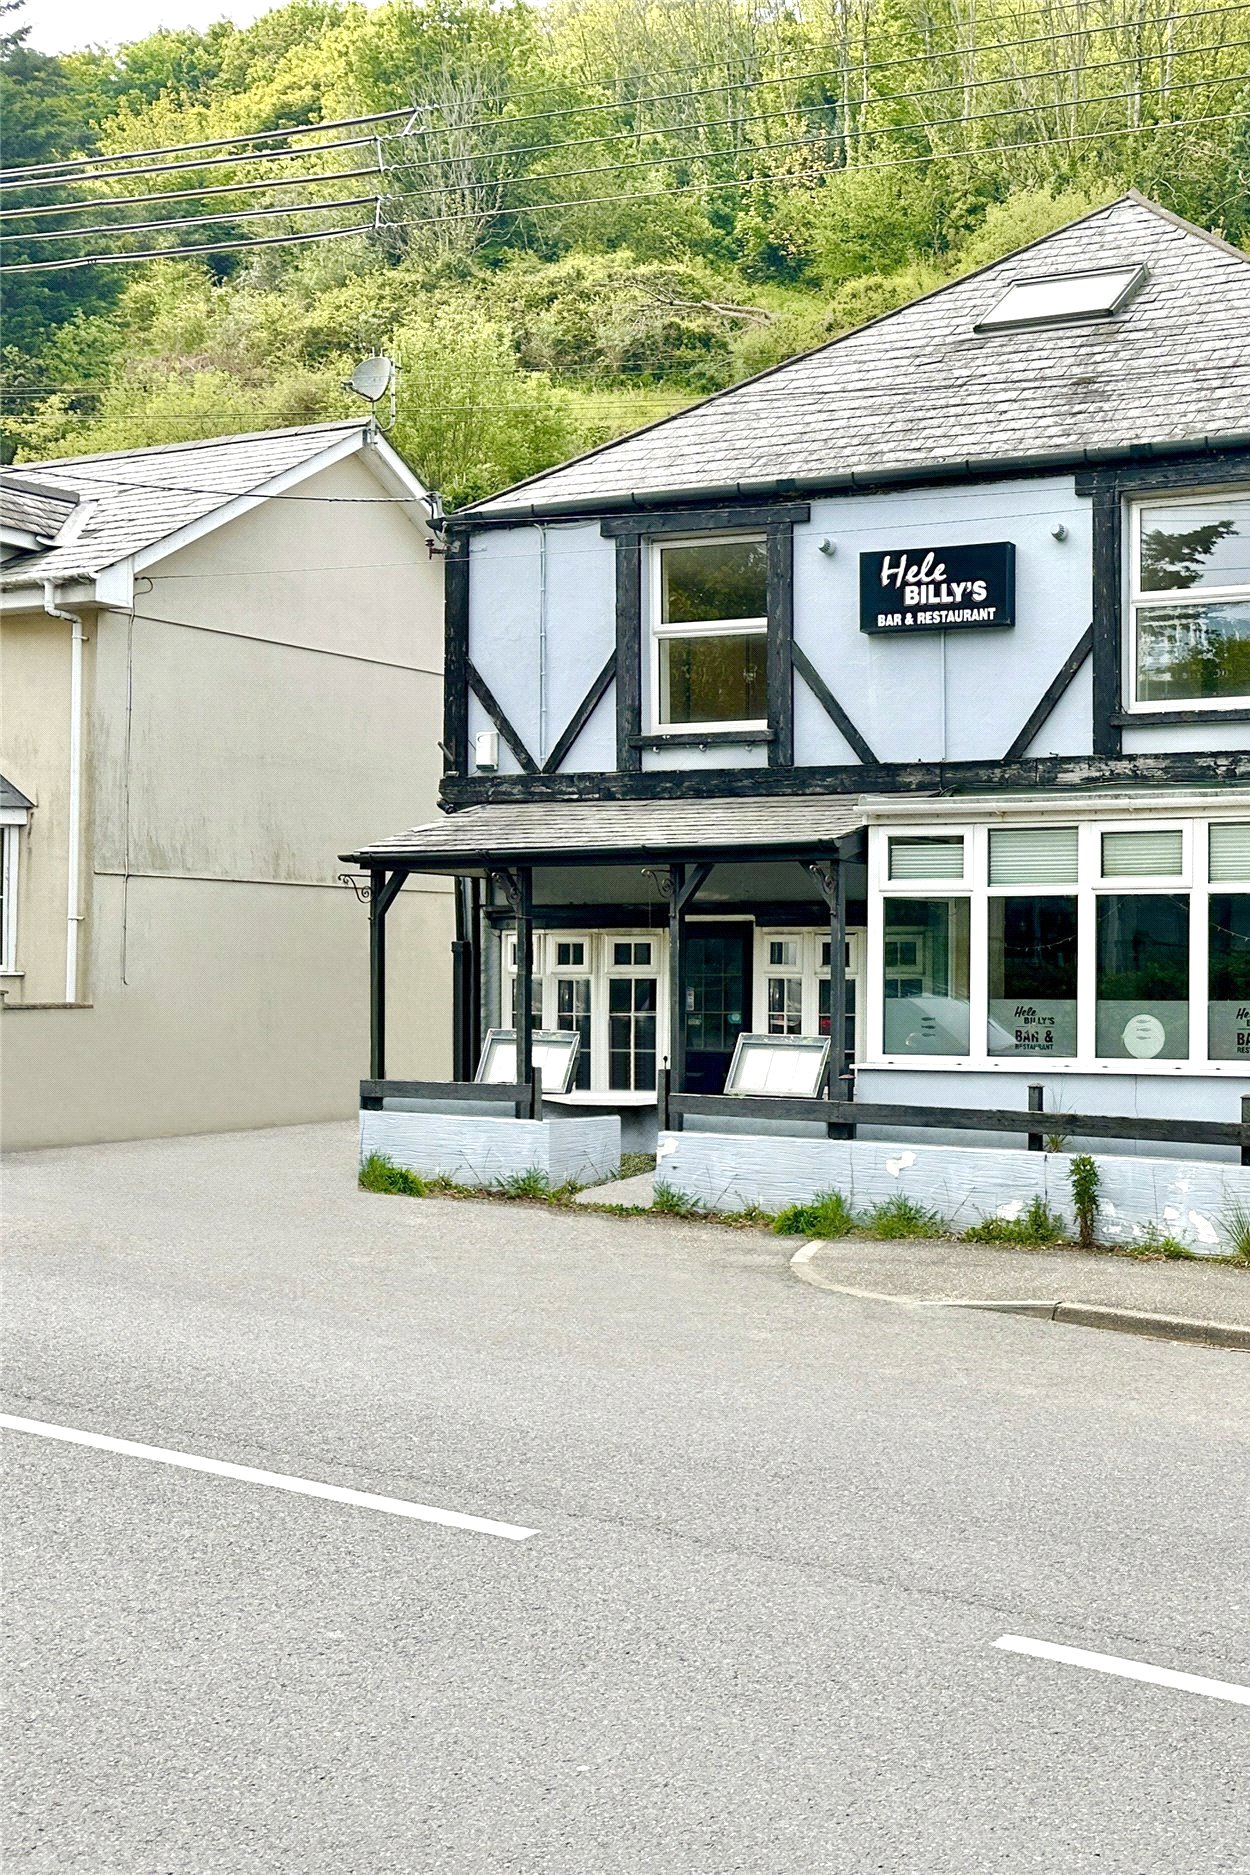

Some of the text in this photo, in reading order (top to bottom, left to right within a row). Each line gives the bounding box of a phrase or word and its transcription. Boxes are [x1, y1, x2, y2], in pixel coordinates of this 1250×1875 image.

[880, 551, 947, 589] Hele
[904, 580, 988, 606] BILLY'S
[877, 607, 997, 627] BAR & RESTAURANT
[1014, 1006, 1037, 1017] Hele
[1024, 1016, 1055, 1025] BILLY'S
[1015, 1030, 1053, 1043] BAR &
